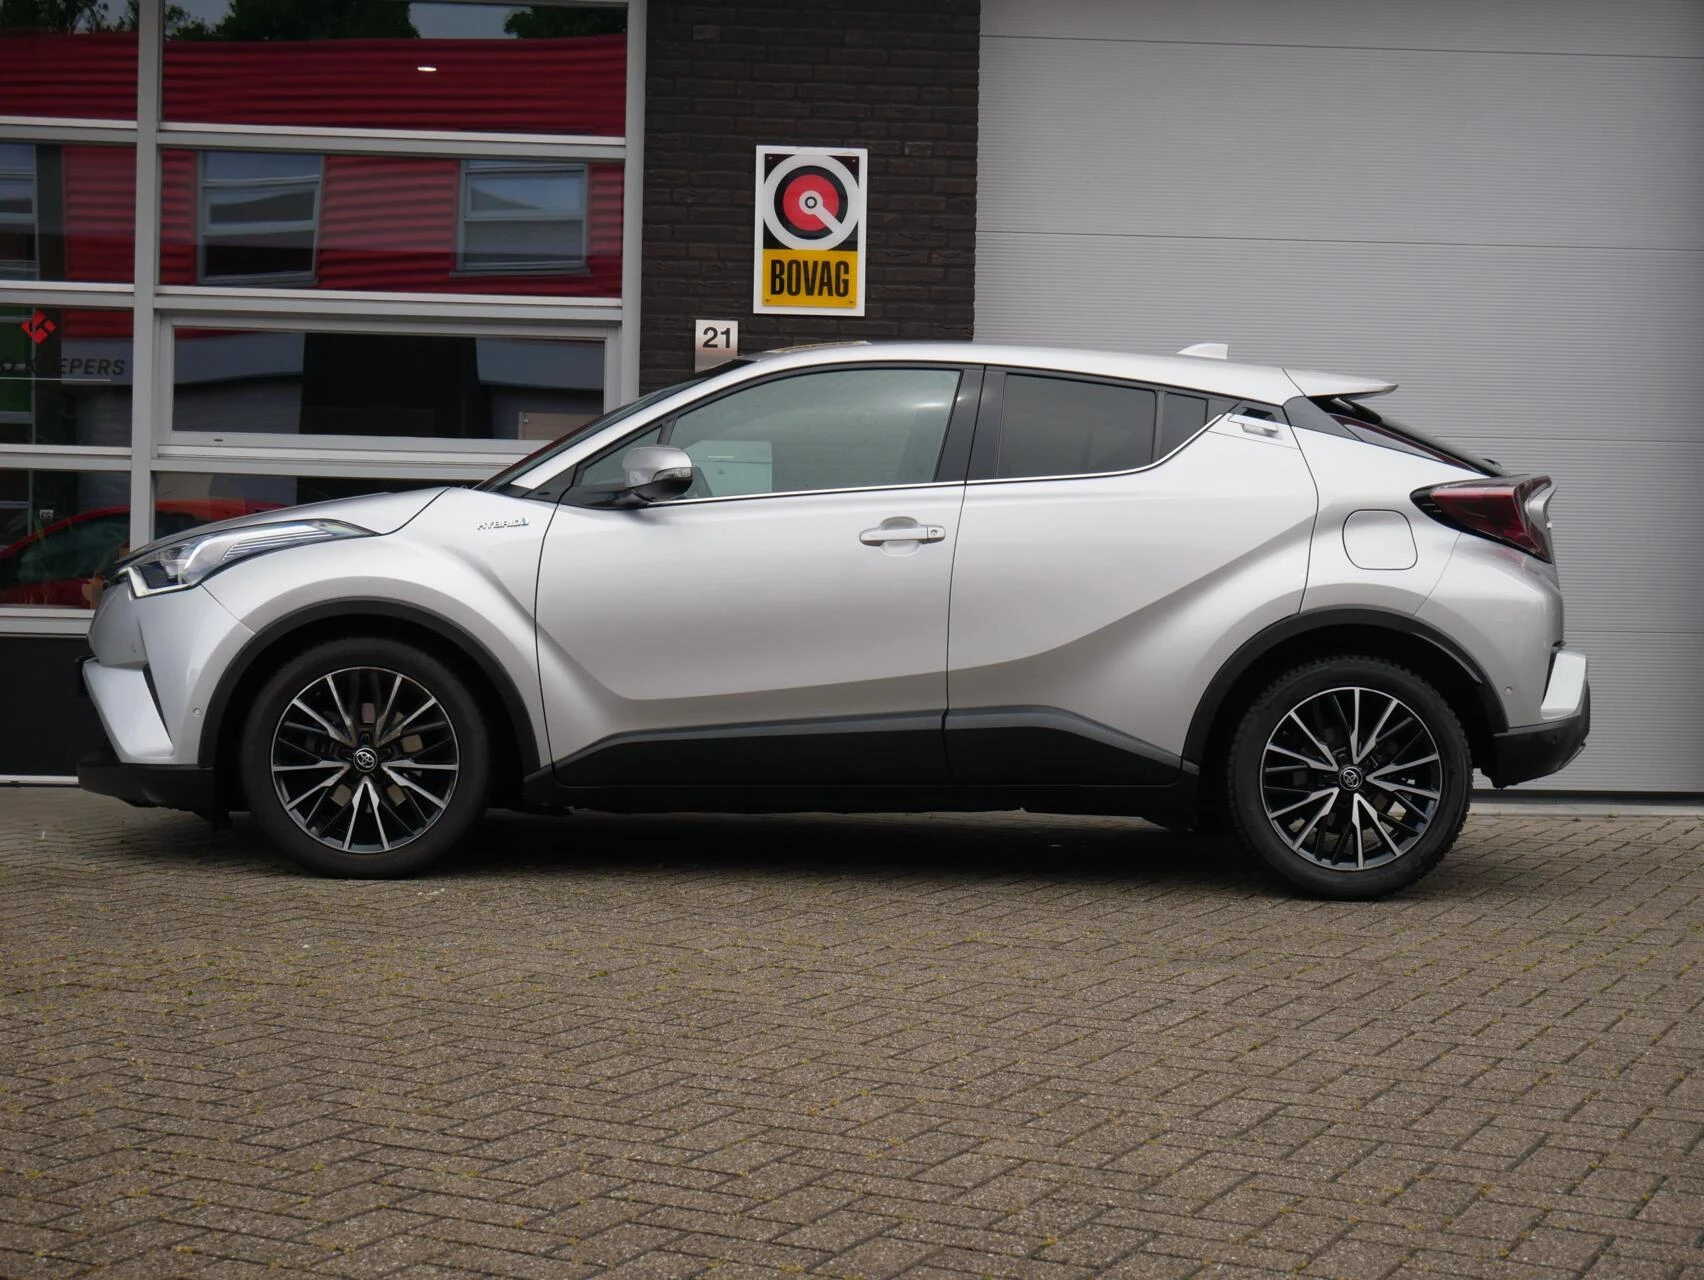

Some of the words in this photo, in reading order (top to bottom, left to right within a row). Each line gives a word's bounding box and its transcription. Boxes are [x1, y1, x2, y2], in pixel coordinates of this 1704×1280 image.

[770, 259, 850, 298] BOVAG
[702, 327, 731, 349] 21
[476, 518, 521, 531] HYBRID
